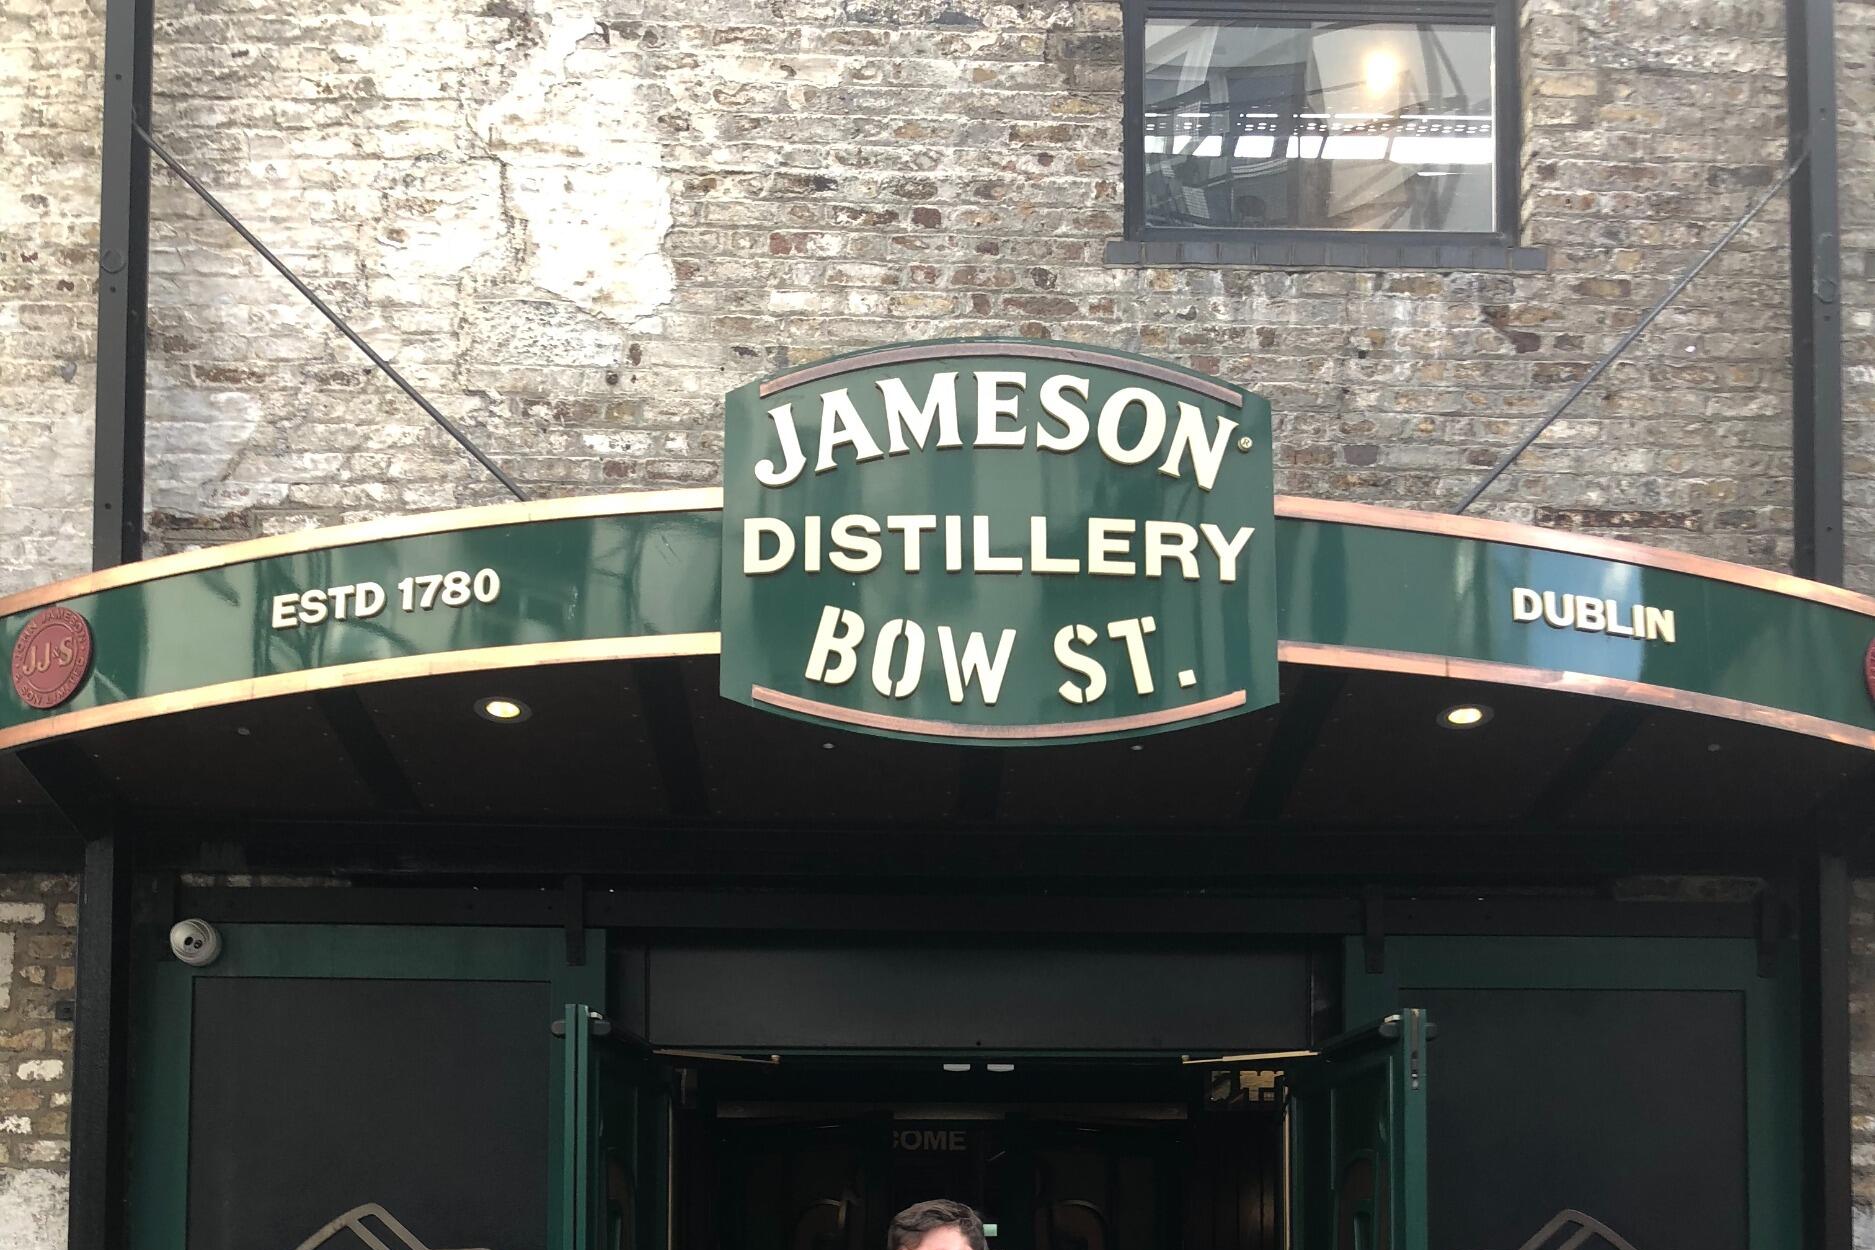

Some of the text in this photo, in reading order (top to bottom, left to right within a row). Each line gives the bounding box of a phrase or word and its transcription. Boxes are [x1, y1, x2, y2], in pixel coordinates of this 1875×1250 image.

[754, 371, 1238, 492] JAMESON
[743, 514, 1255, 583] DISTILLERY
[271, 568, 501, 630] ESTD 1780
[1512, 587, 1676, 643] DUBLIN
[804, 605, 1197, 706] BOW ST.
